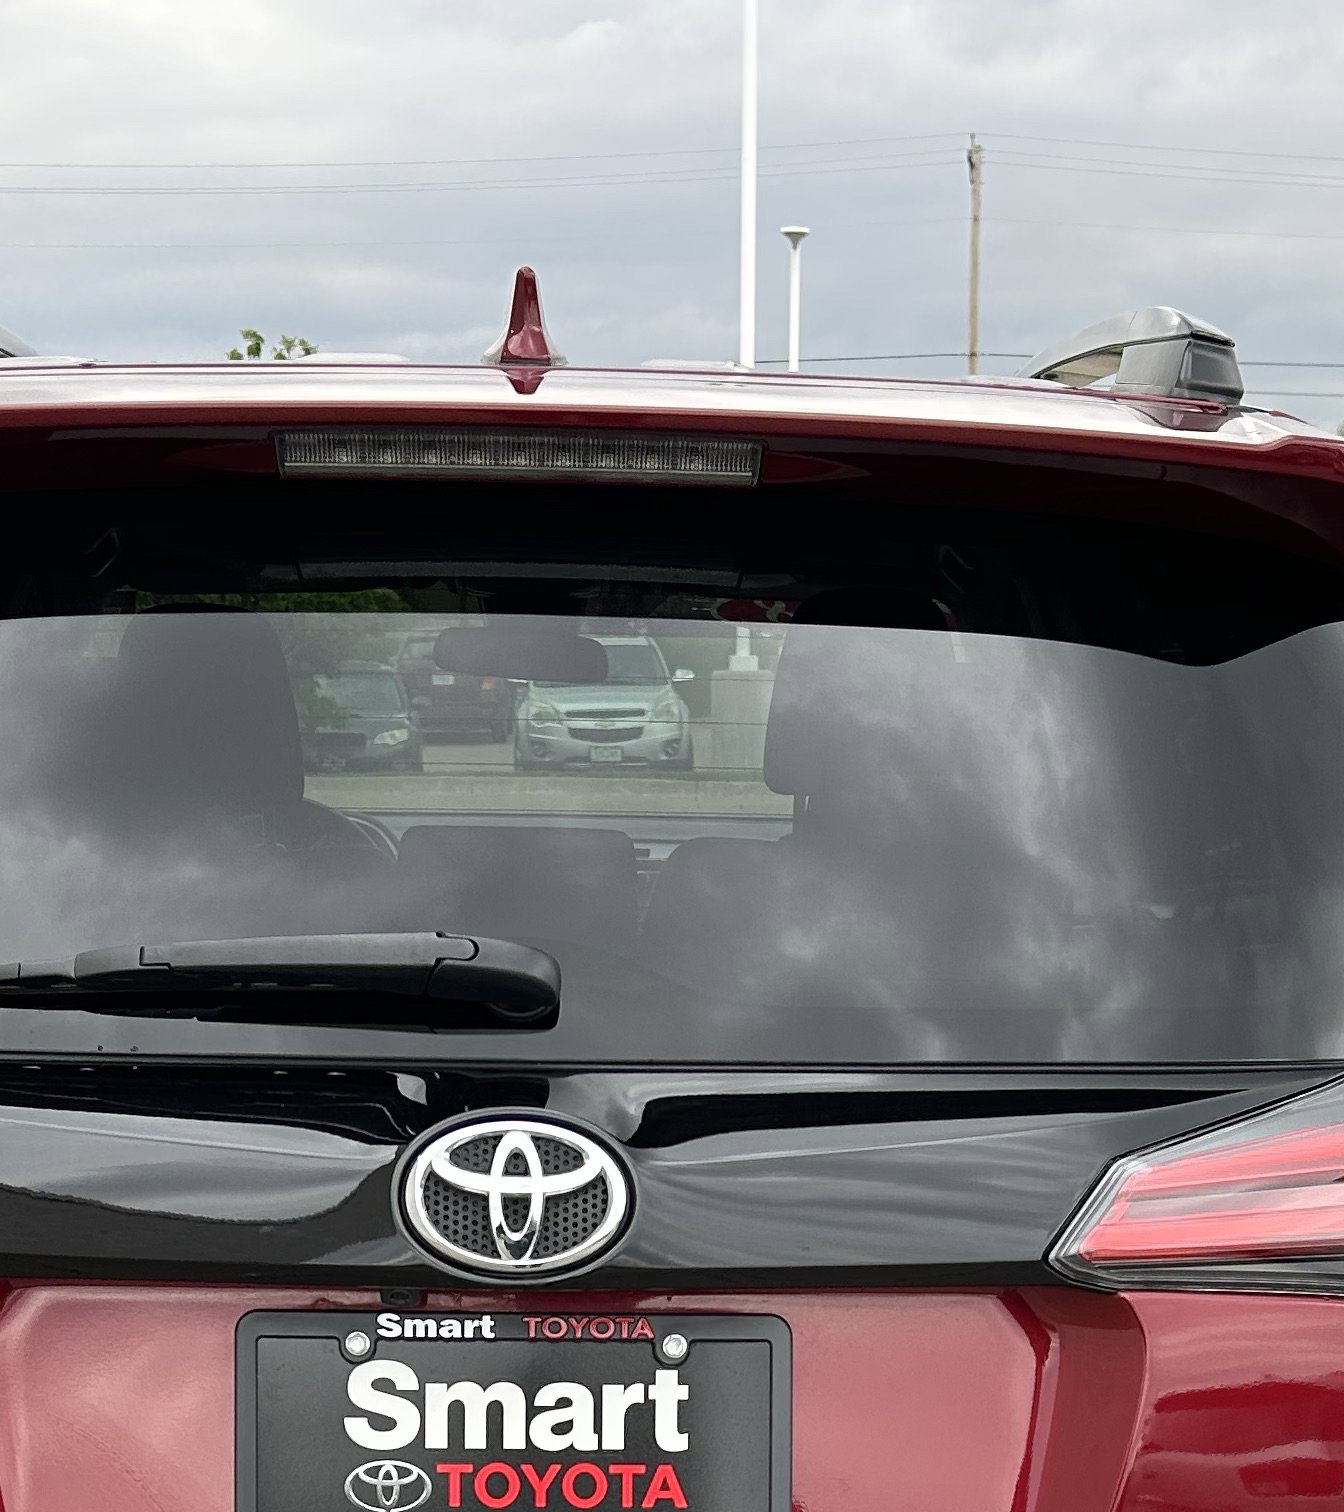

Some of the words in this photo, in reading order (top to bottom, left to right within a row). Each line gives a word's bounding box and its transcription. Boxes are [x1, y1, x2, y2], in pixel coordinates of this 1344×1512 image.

[376, 1313, 495, 1339] Smart
[522, 1316, 655, 1339] TOYOTA
[343, 1359, 690, 1453] Smart
[435, 1461, 689, 1510] TOYOTA
